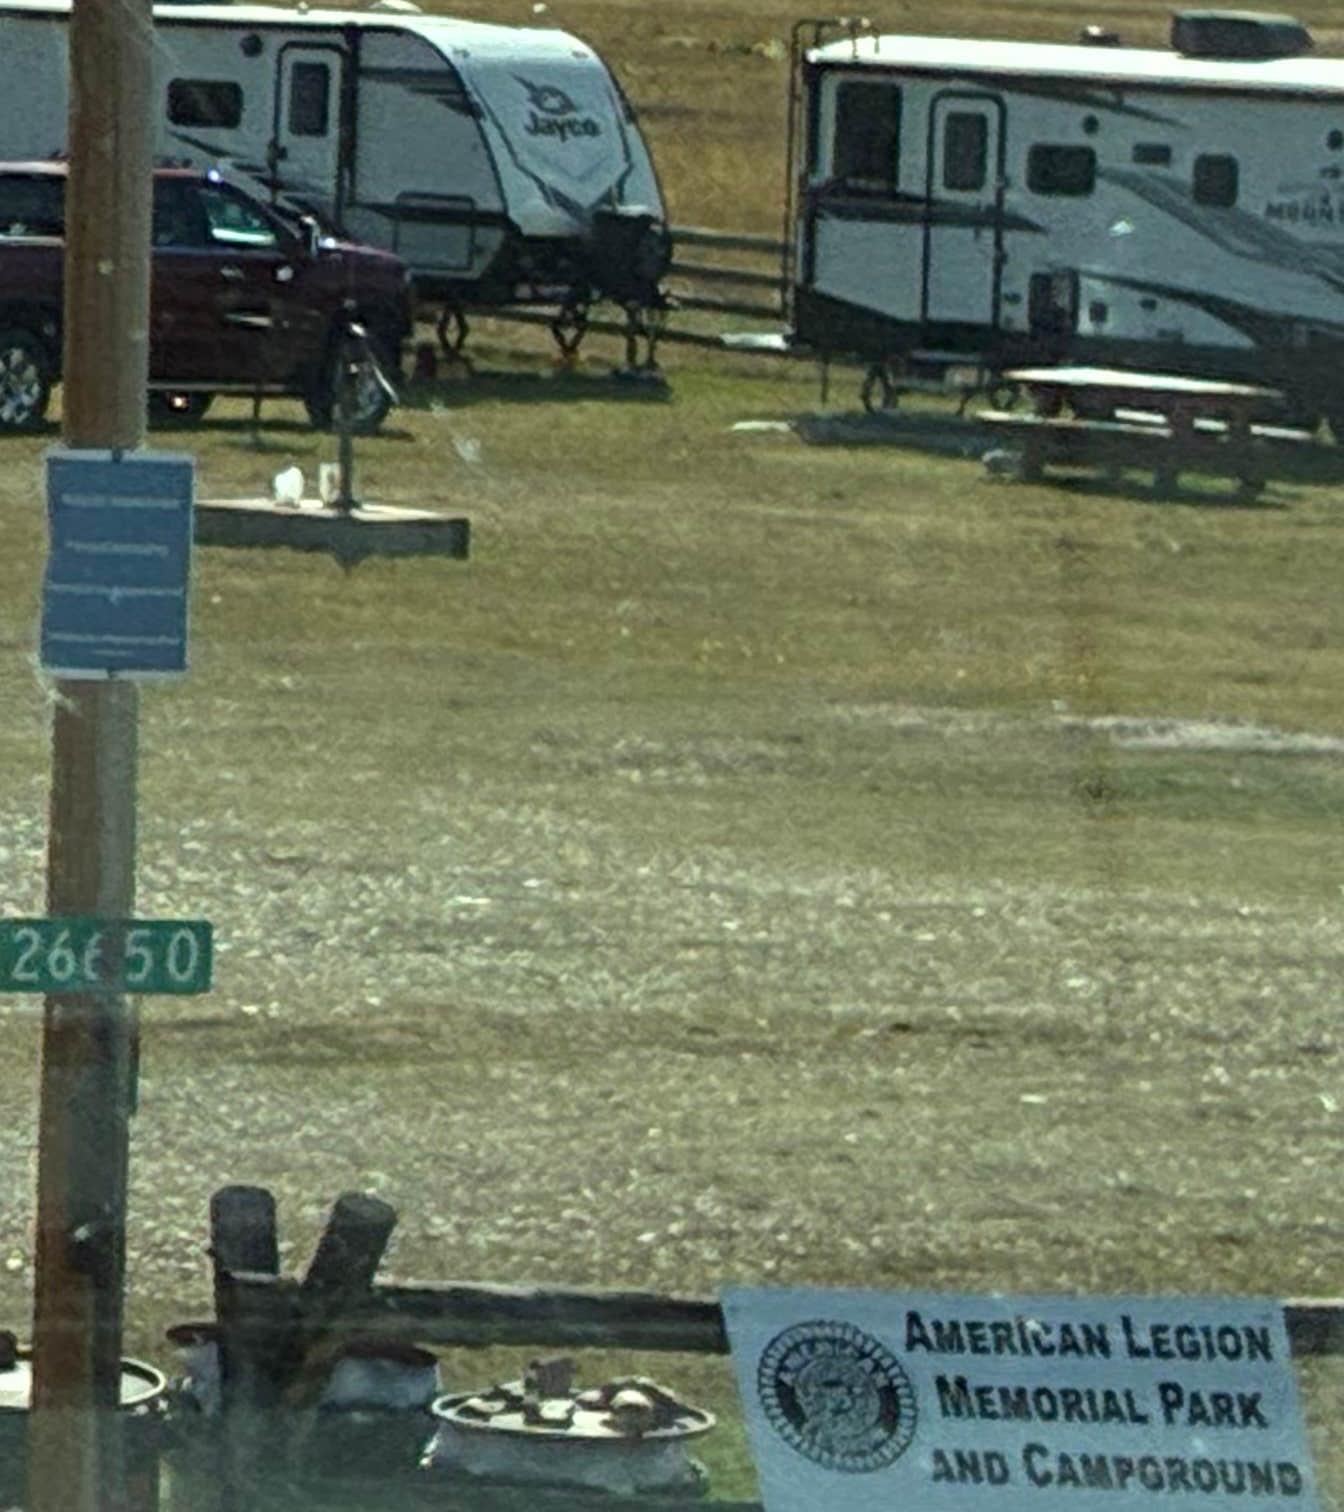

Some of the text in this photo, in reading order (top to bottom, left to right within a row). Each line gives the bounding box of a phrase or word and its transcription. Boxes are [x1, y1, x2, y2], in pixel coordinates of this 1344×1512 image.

[524, 110, 601, 143] Jayco
[905, 1310, 1274, 1362] AMERICAN LEGION
[934, 1374, 1269, 1429] MEMORIAL PARK
[932, 1442, 1303, 1496] AND CAMPGROUND
